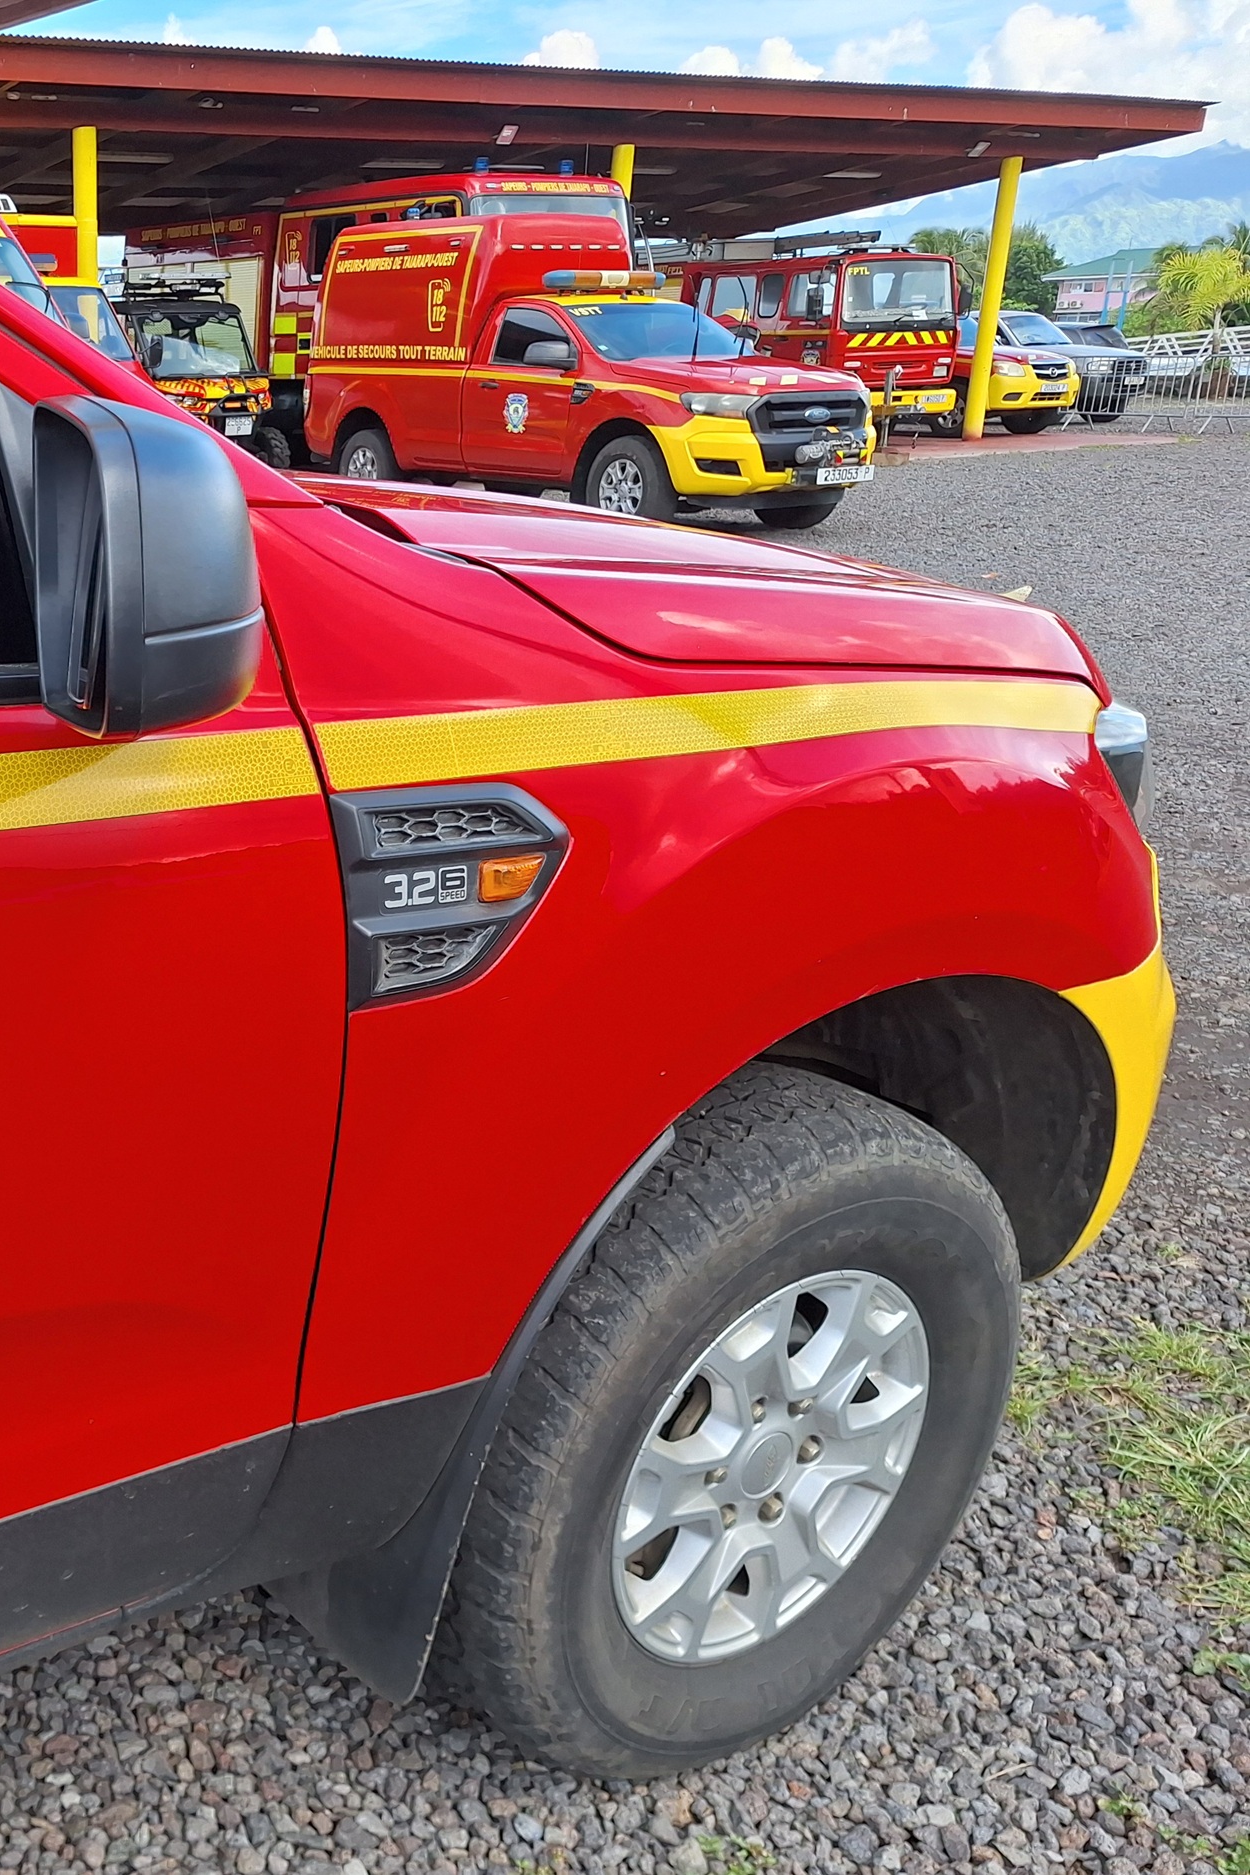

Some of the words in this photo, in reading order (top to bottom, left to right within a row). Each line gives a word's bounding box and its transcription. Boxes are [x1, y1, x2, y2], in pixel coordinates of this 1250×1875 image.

[289, 238, 297, 250] 18
[392, 256, 404, 270] DE
[848, 266, 871, 275] FPTL
[432, 288, 444, 305] 18
[432, 305, 447, 322] 112
[568, 305, 603, 317] VSTT
[346, 345, 358, 359] DE
[358, 345, 397, 359] SECOURS
[399, 345, 423, 360] TOUT
[424, 346, 466, 362] TERRAIN
[823, 467, 859, 482] 233053
[384, 870, 436, 909] 3.2
[440, 889, 465, 901] SPEED
